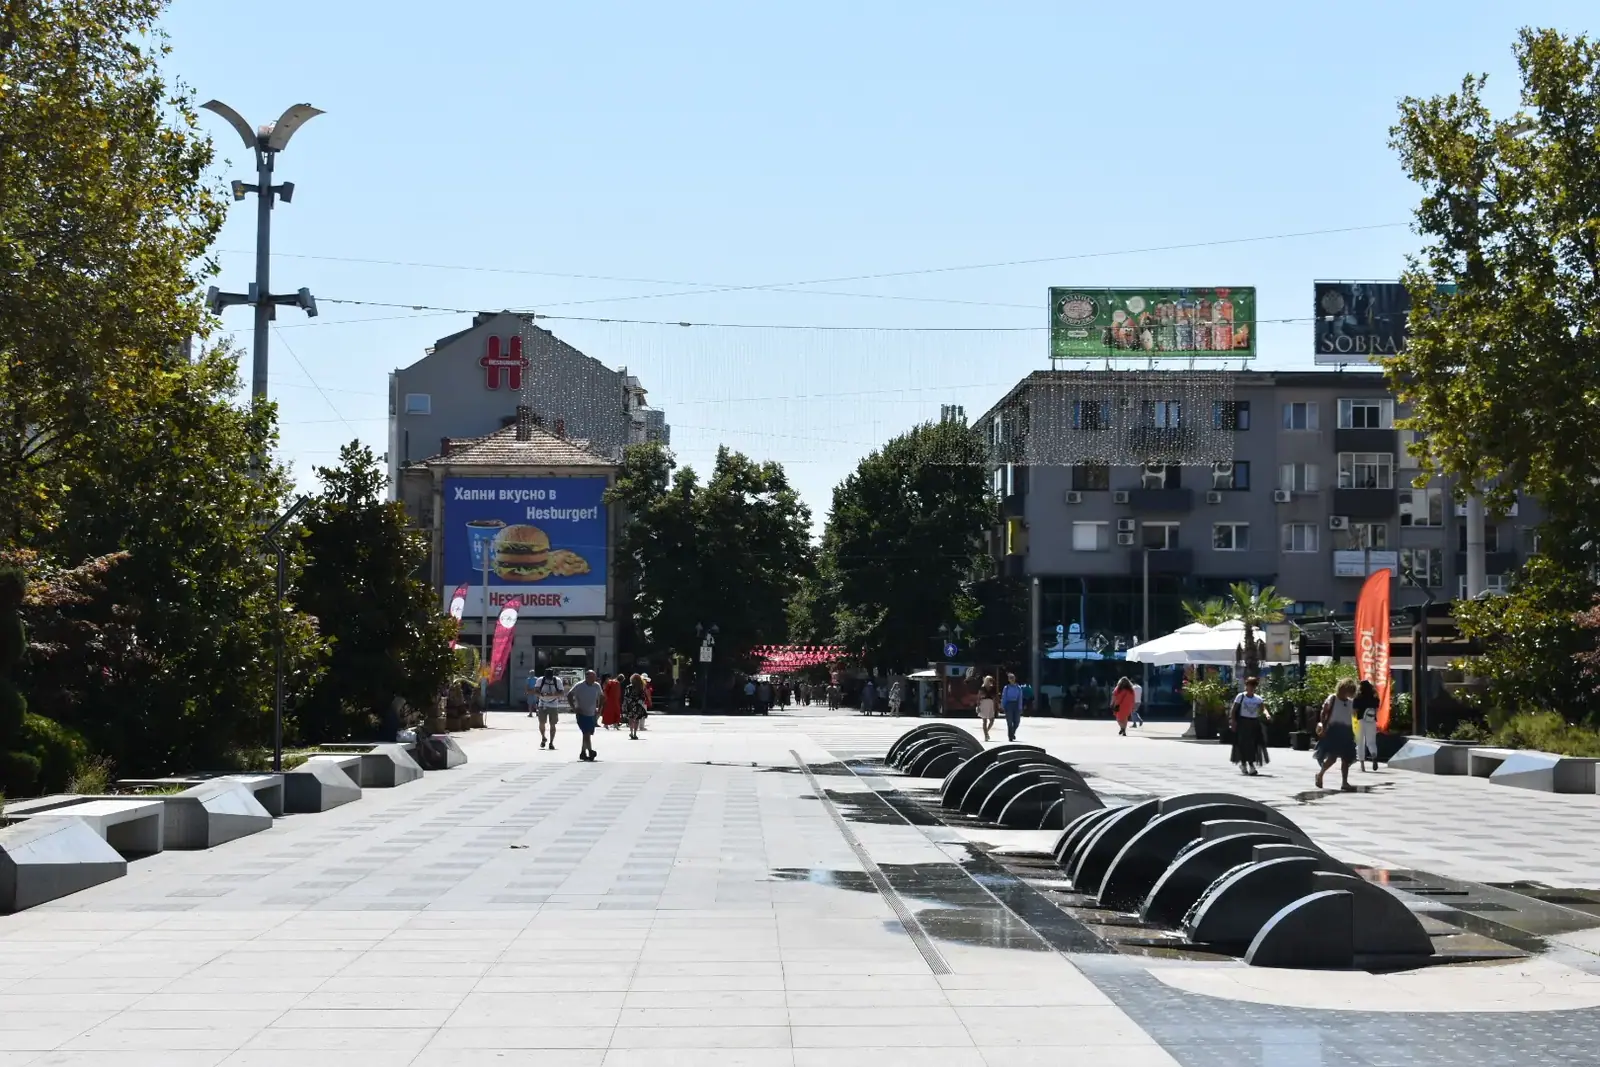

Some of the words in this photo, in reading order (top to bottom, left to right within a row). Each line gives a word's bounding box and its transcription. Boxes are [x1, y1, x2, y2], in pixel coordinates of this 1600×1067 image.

[454, 487, 496, 501] Хапни
[499, 489, 546, 503] вкусно
[549, 489, 557, 501] в
[526, 506, 598, 522] Hesburger!
[489, 592, 562, 607] HESURGER
